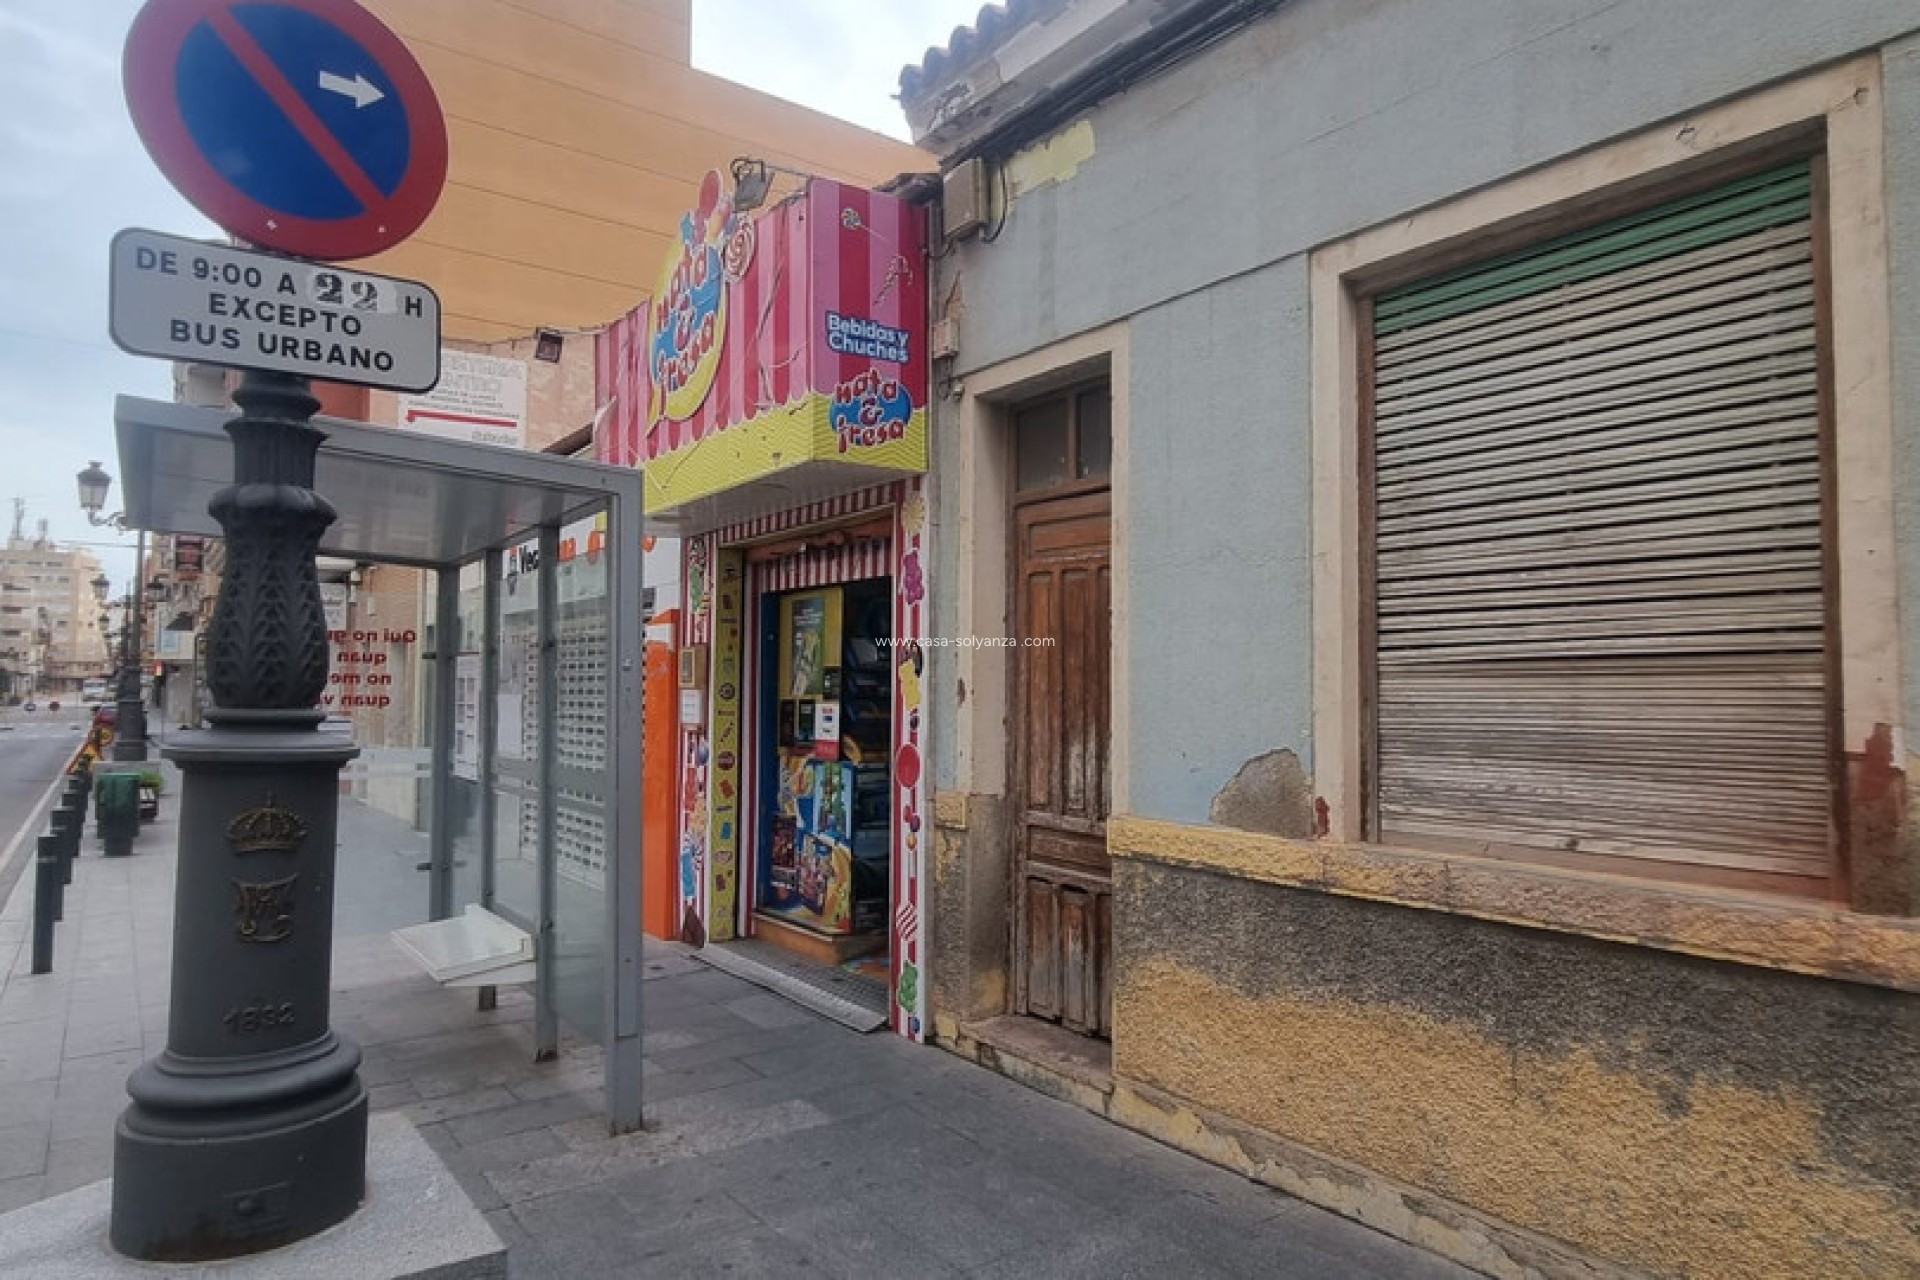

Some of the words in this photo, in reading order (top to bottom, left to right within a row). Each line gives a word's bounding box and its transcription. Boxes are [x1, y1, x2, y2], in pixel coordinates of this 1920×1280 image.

[135, 247, 178, 275] DE
[192, 257, 262, 288] 9:00
[277, 272, 297, 296] A
[314, 273, 379, 312] 22
[404, 295, 424, 319] H
[208, 293, 362, 336] EXCEPTO
[828, 314, 896, 341] Bebidas
[170, 318, 241, 349] BUS
[257, 332, 394, 372] URBANO
[829, 333, 909, 363] Chuches
